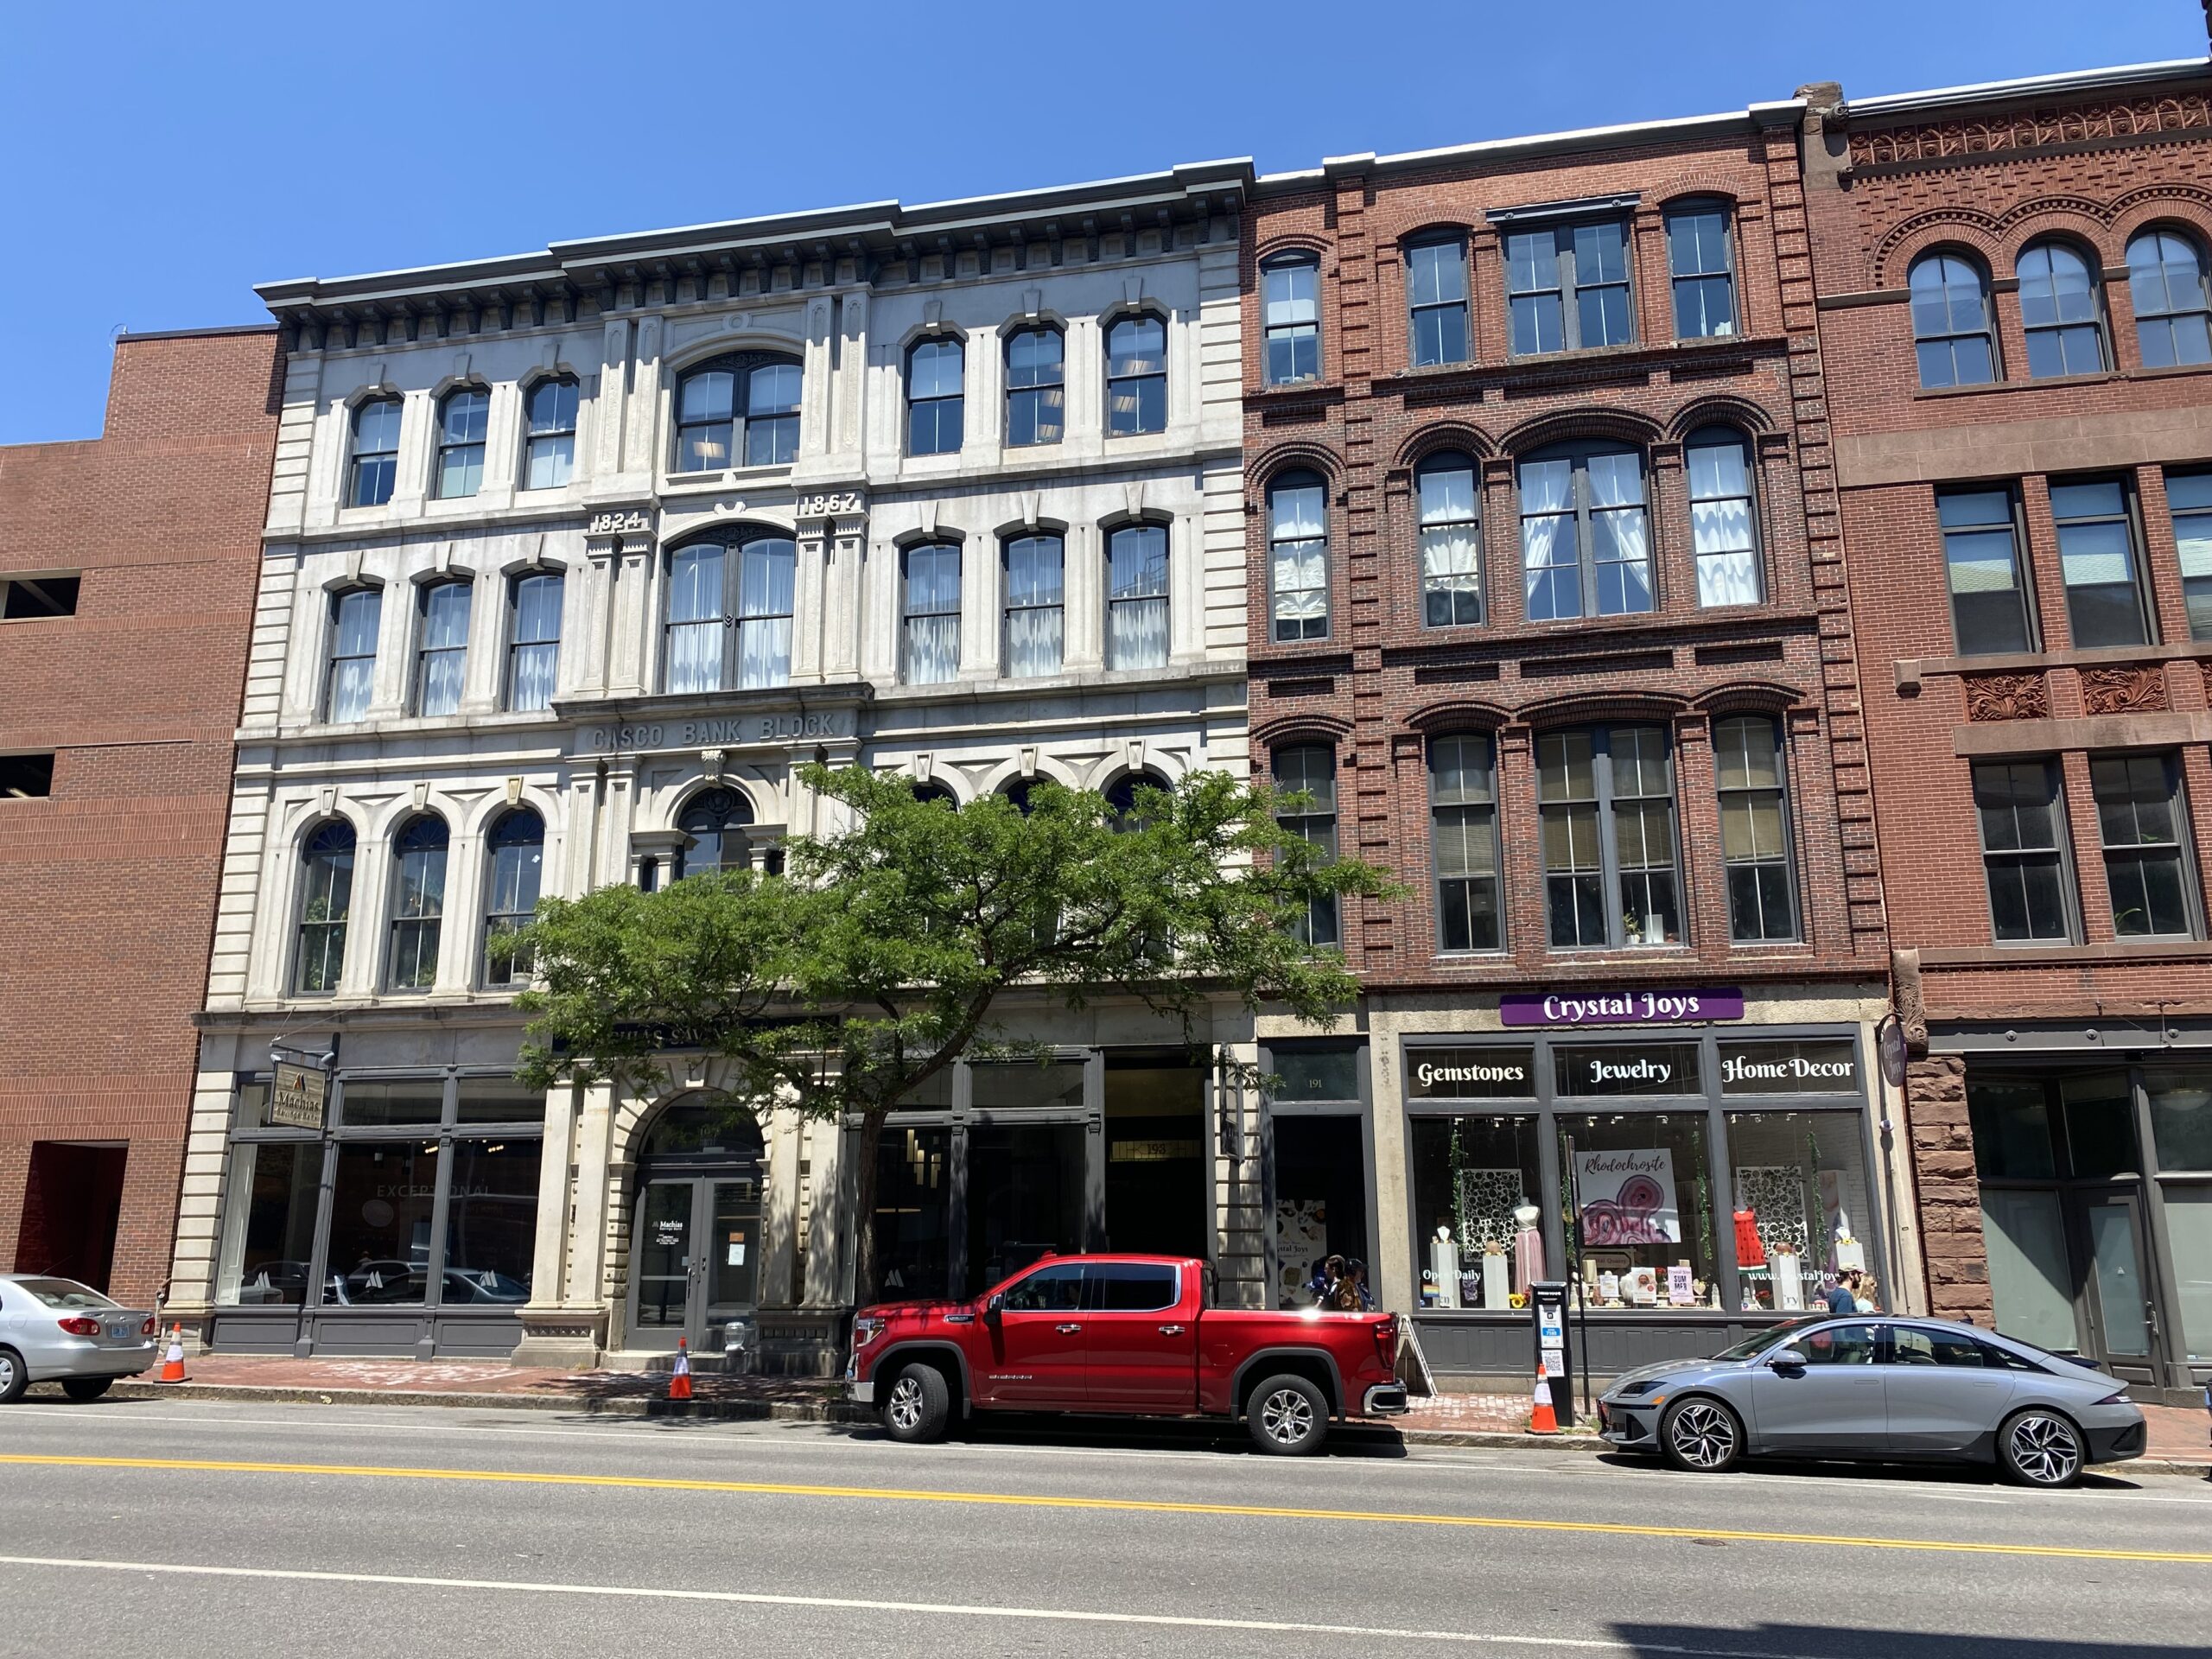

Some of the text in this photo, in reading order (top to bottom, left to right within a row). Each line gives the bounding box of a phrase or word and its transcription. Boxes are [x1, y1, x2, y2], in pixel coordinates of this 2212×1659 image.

[804, 493, 855, 514] 1867
[594, 512, 641, 531] 1824
[593, 715, 834, 750] CASCO BANK BLOCK
[1543, 993, 1700, 1022] Crystal Joys
[1417, 1063, 1524, 1087] Gemstones
[1590, 1059, 1671, 1083] Jewelry
[1722, 1056, 1853, 1083] Home Decor
[1309, 1079, 1322, 1088] 191
[278, 1091, 319, 1112] Machias
[1147, 1143, 1166, 1154] 193
[1585, 1153, 1666, 1174] Rhodochrosite
[1454, 1269, 1481, 1282] Daily
